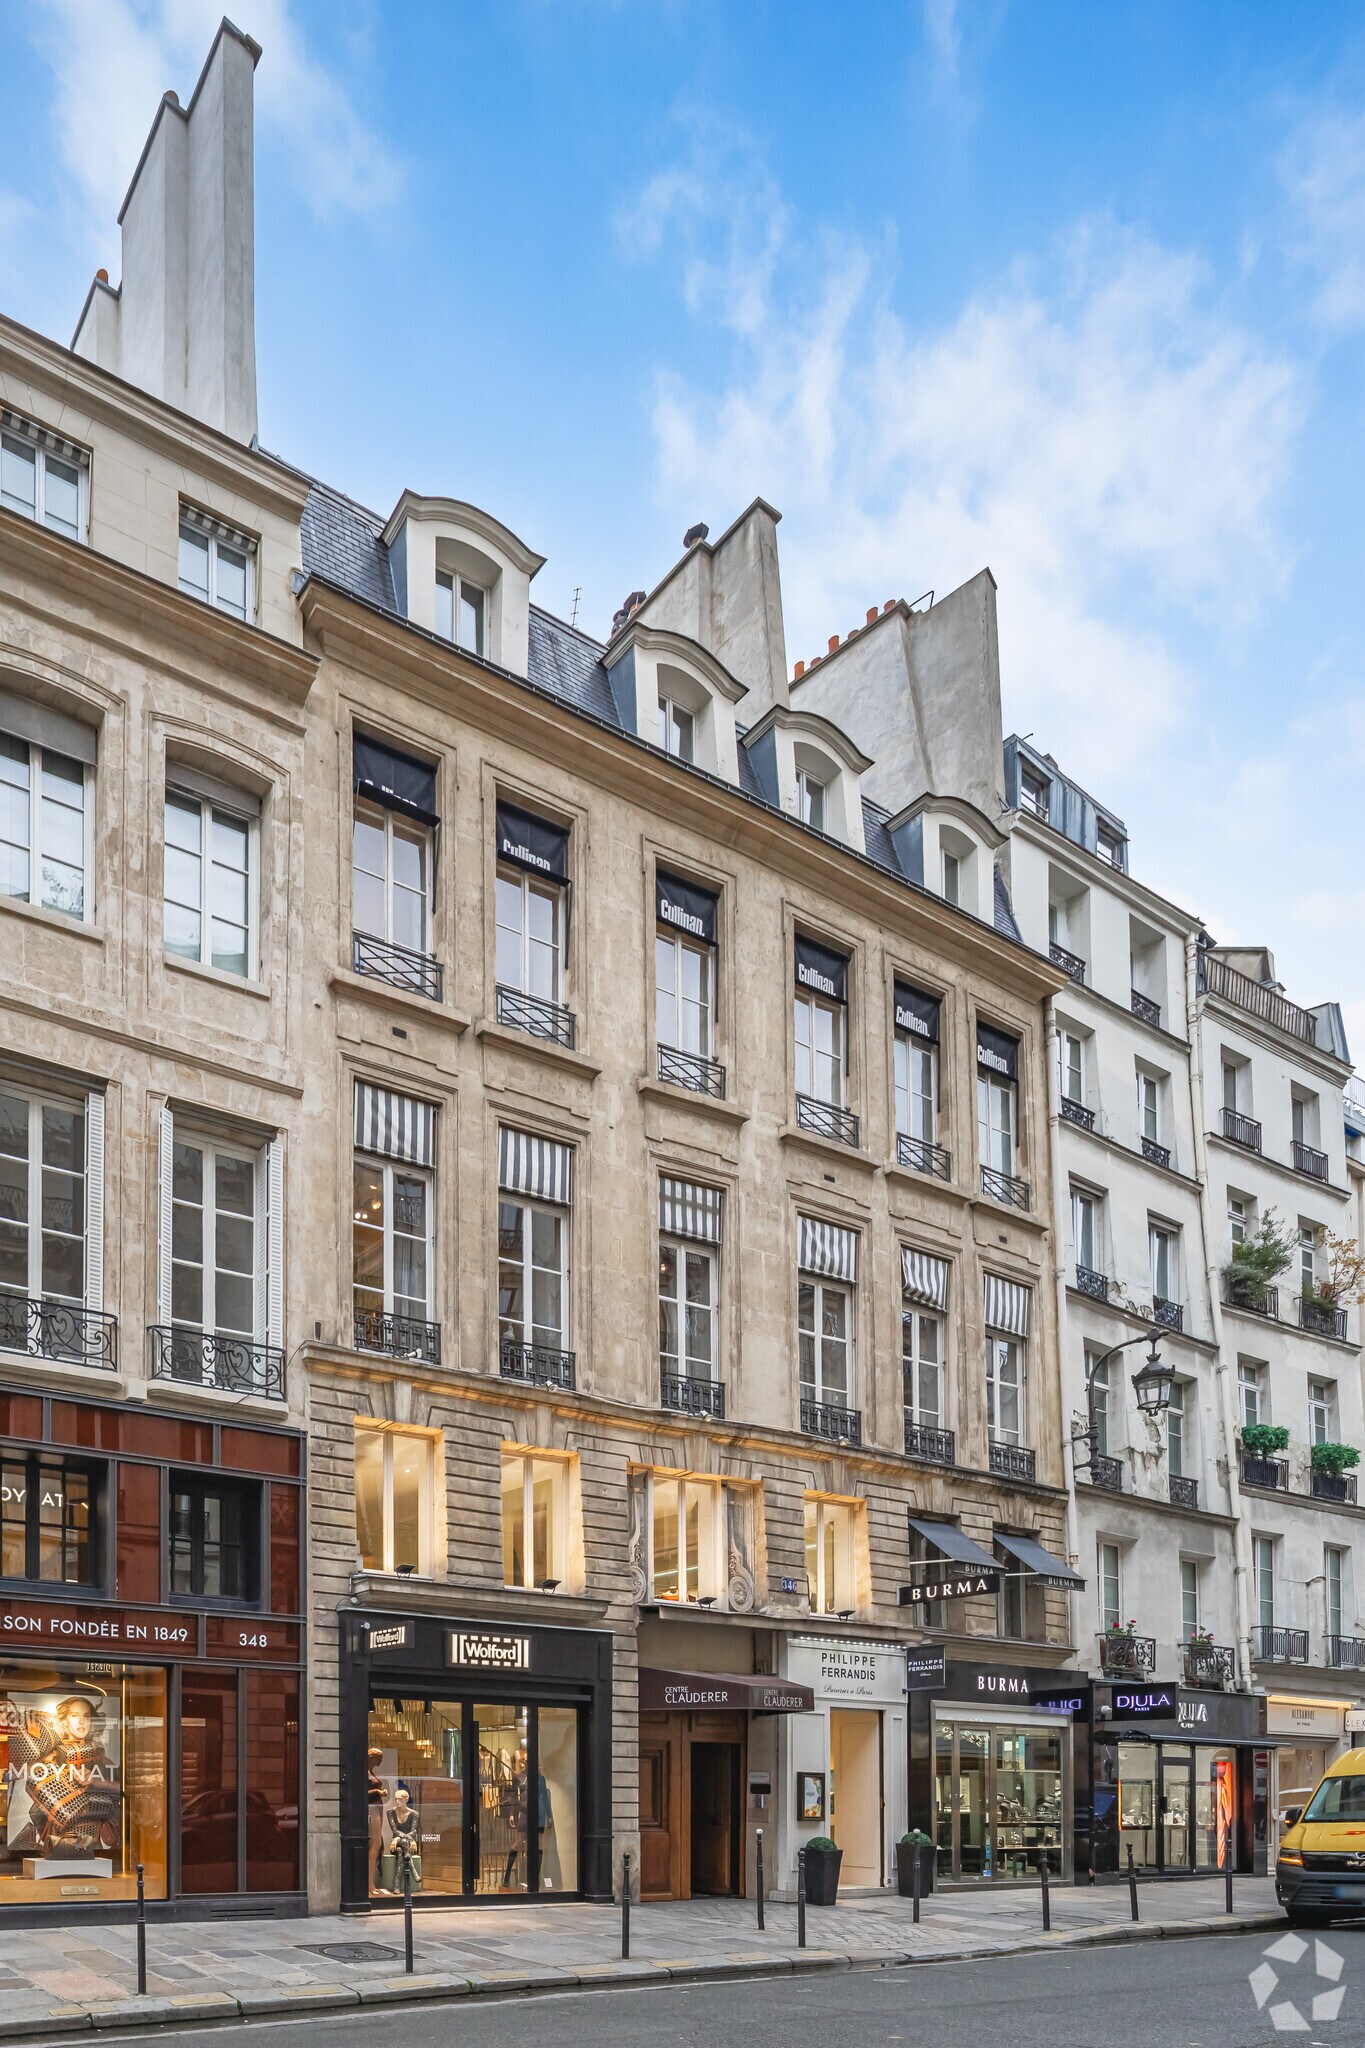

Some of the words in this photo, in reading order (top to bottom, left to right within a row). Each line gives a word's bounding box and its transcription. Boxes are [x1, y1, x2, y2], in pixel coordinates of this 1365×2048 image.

[661, 898, 705, 937] Cullinan.
[798, 963, 837, 997] Cullinan.
[896, 1005, 930, 1037] Cullinan.
[977, 1044, 1009, 1075] Cullinan.
[965, 1563, 994, 1575] BURMA
[783, 1579, 797, 1591] 346
[912, 1578, 987, 1600] BURMA
[1048, 1576, 1075, 1588] BURMA
[50, 1619, 119, 1637] FONDÉE
[126, 1625, 147, 1639] EN
[154, 1627, 188, 1642] 1849
[239, 1633, 267, 1648] 348
[464, 1641, 517, 1661] Wolford
[821, 1652, 876, 1667] PHILIPPE
[908, 1658, 944, 1667] PHILIPPE
[821, 1667, 876, 1681] FERRANDIS
[908, 1664, 944, 1672] FERRANDIS
[665, 1686, 689, 1694] CENTRE
[978, 1675, 1029, 1693] BURMA
[665, 1691, 728, 1704] CLAUDERER
[763, 1695, 803, 1708] CLAUDERER
[1116, 1694, 1171, 1709] DJULA
[8, 1761, 120, 1783] MOYNAT
